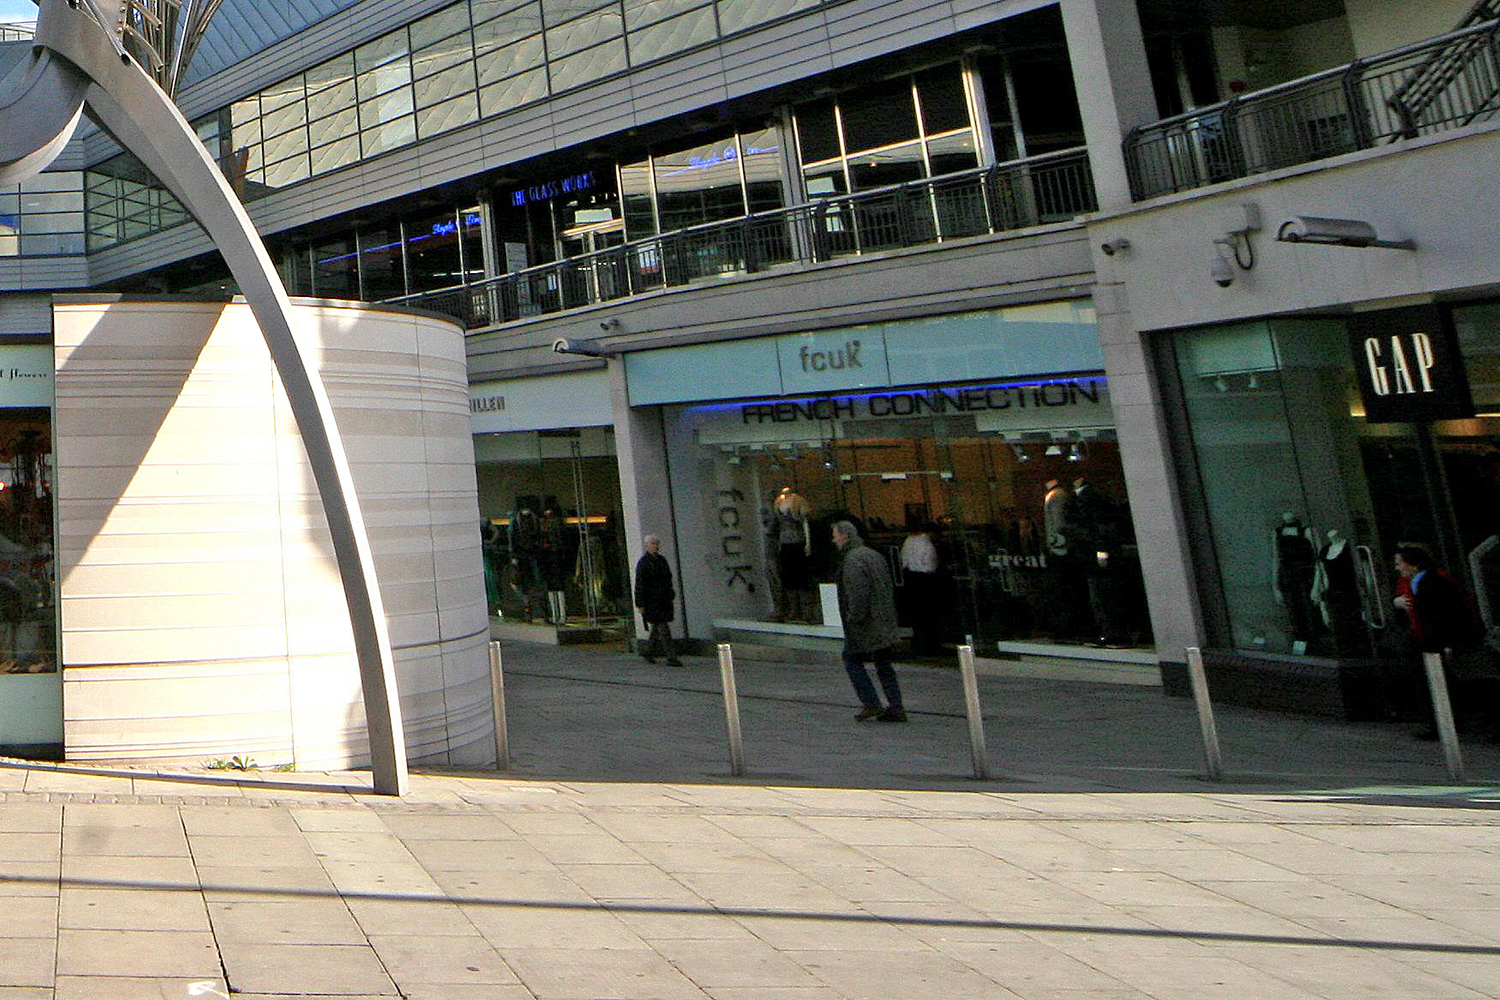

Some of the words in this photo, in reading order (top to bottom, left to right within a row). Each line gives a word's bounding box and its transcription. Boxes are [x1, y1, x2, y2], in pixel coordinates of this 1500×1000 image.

[529, 180, 559, 201] GLASS
[799, 339, 863, 373] fcuk
[1364, 332, 1435, 396] GAP
[741, 397, 855, 424] FRENCH
[868, 381, 1099, 416] CONNECTION
[714, 488, 756, 593] fcuk
